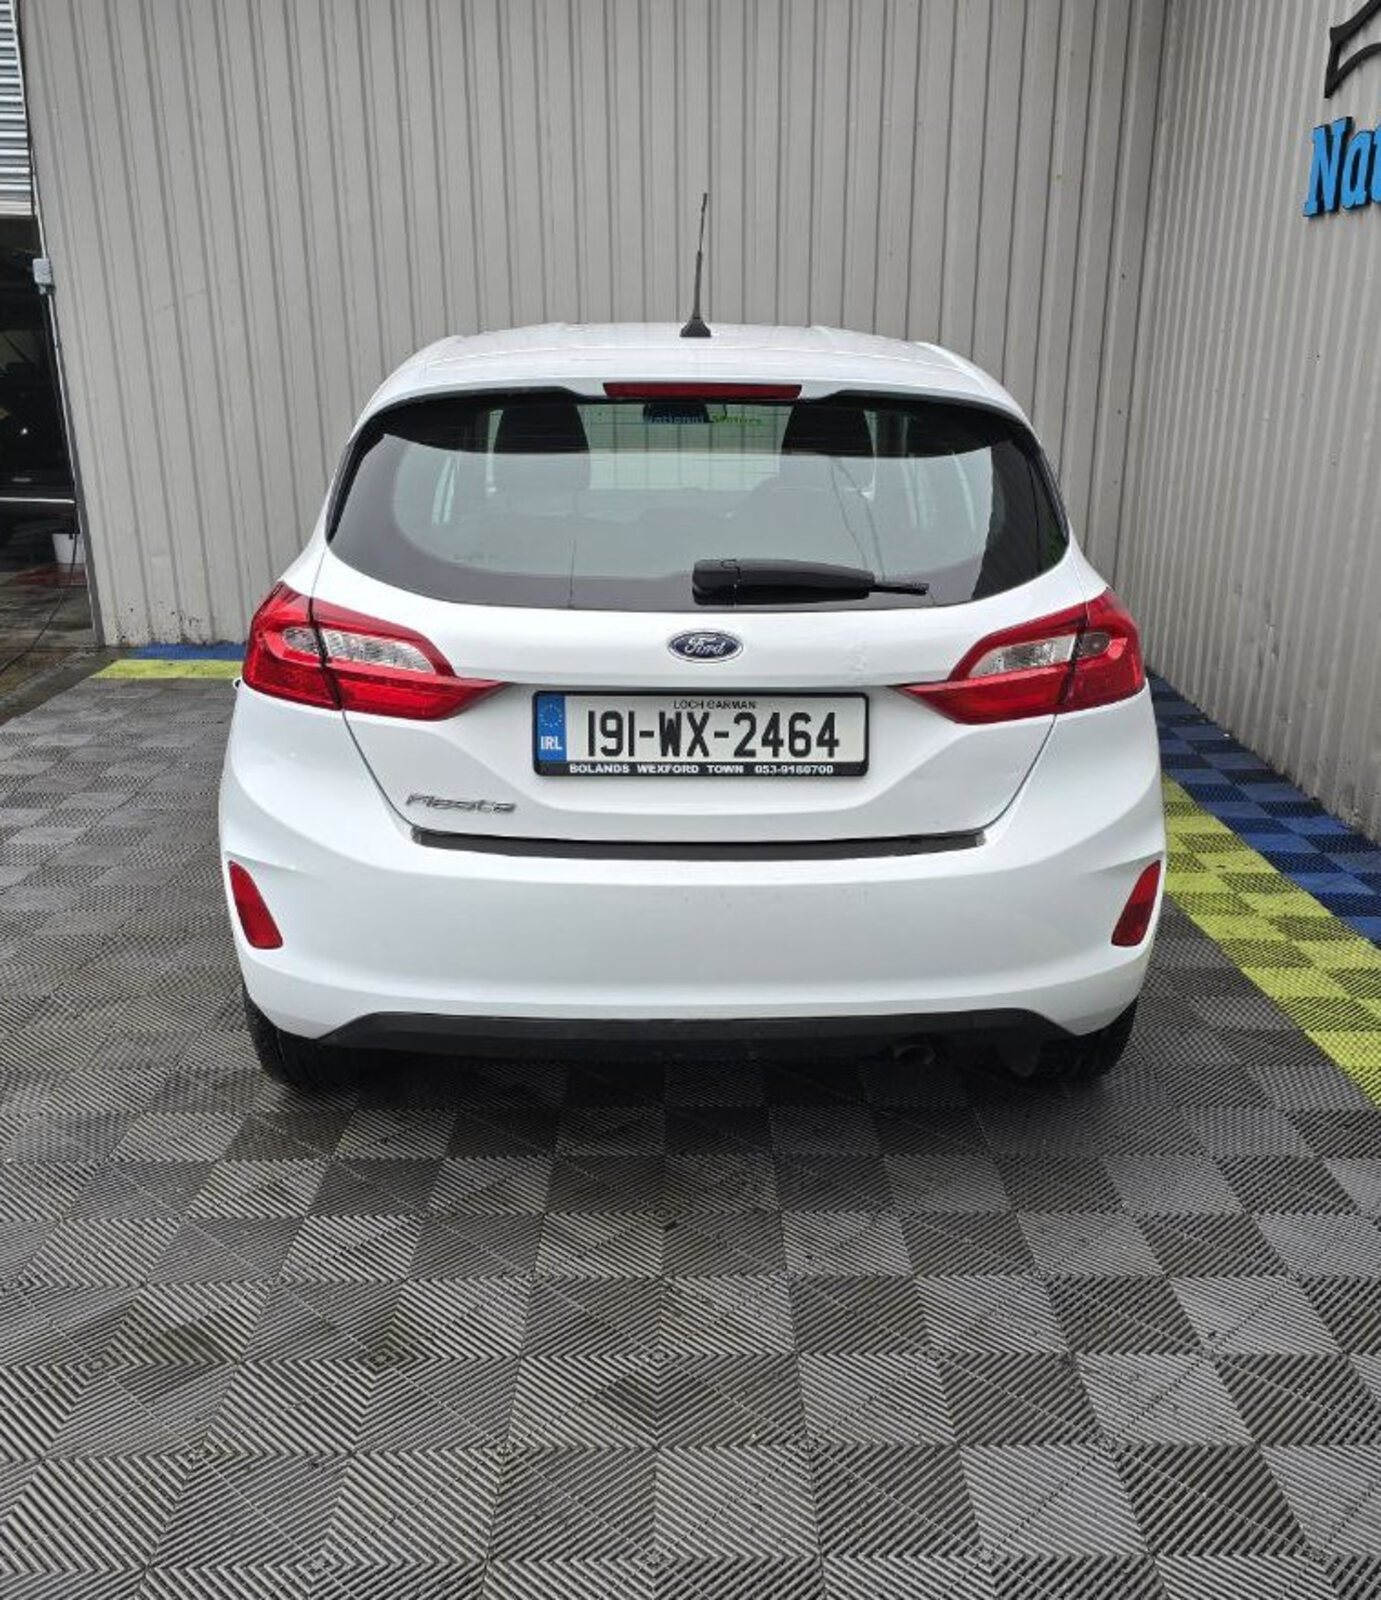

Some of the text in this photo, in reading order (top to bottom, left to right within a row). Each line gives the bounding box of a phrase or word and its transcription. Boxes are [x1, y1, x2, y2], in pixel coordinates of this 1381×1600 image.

[684, 636, 727, 656] Ford
[673, 699, 704, 710] LOCH
[540, 735, 563, 750] IRL
[587, 711, 840, 758] 191-WX-2464
[569, 763, 630, 774] BOLANDS
[637, 763, 700, 774] WEXFORD
[706, 764, 745, 775] TOWN
[405, 793, 517, 814] Fiesta
